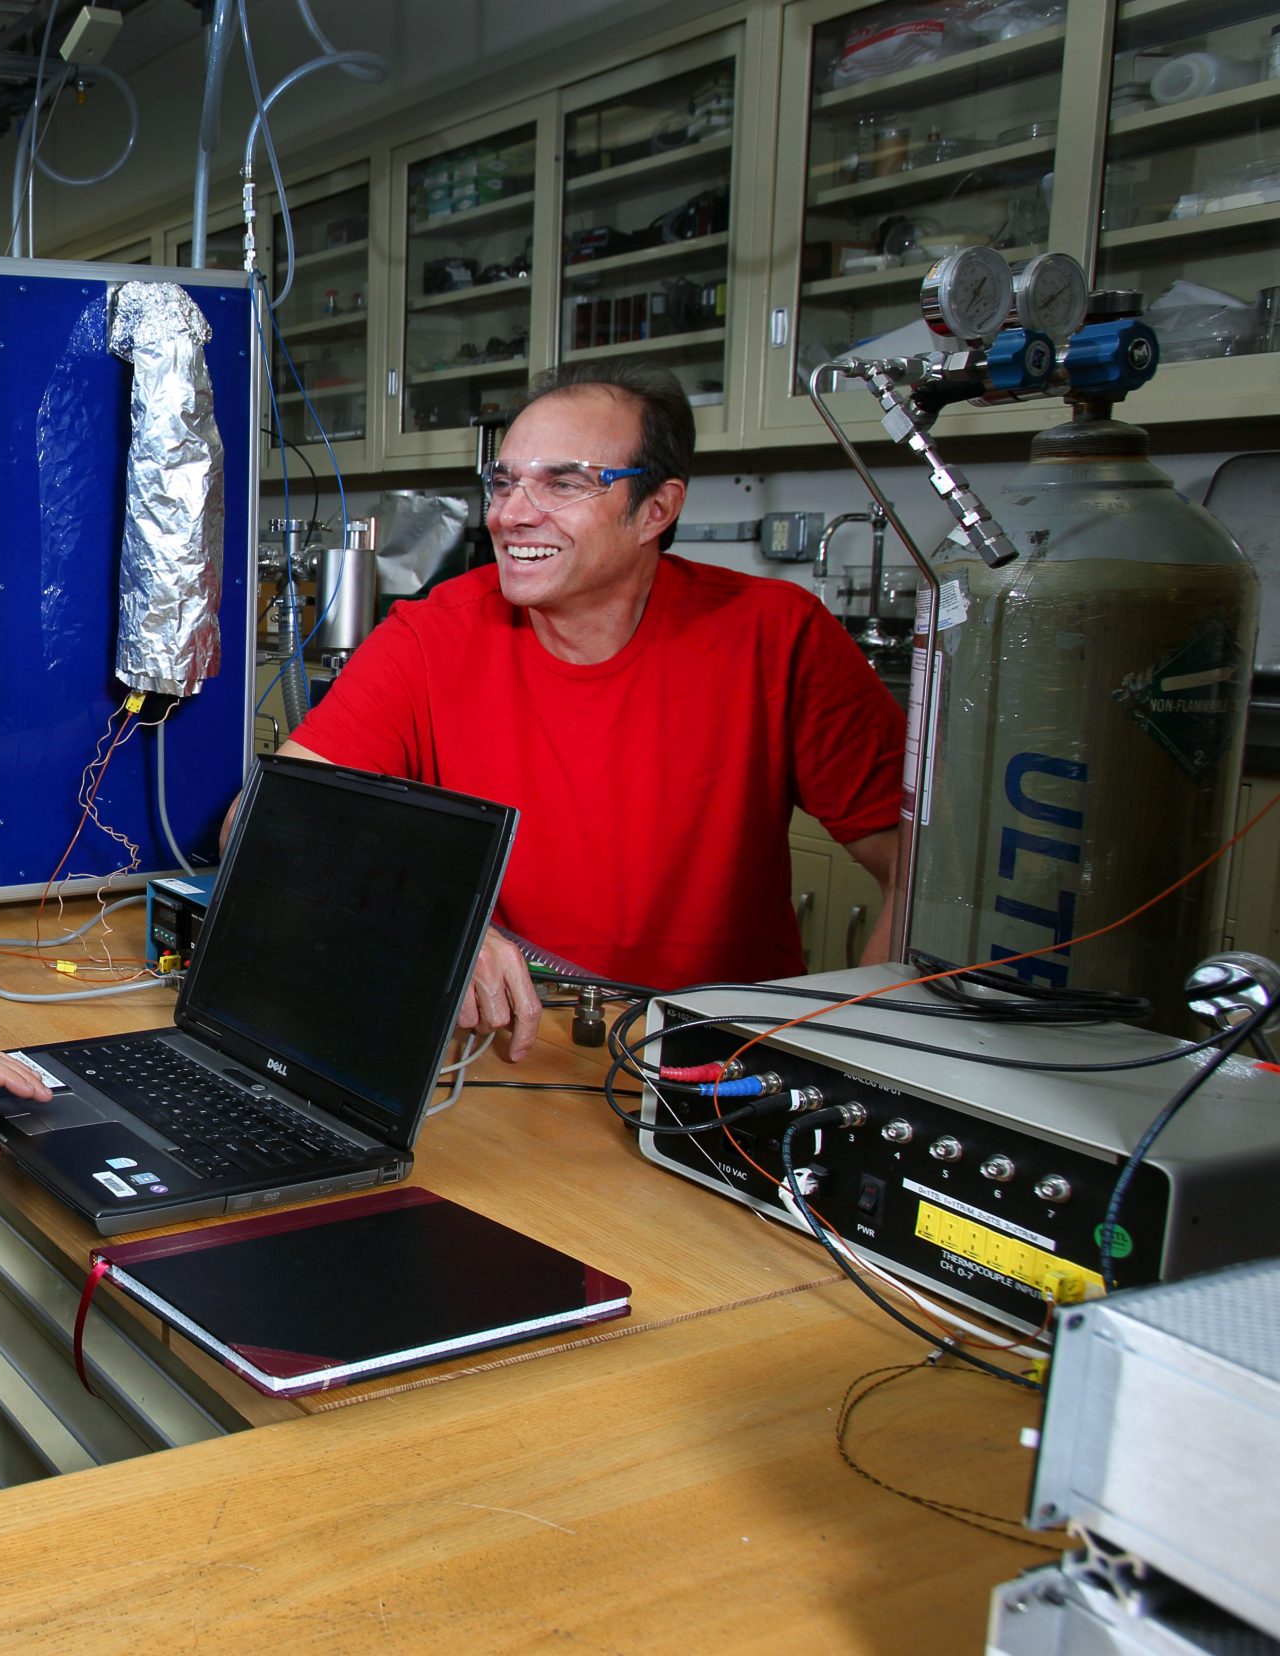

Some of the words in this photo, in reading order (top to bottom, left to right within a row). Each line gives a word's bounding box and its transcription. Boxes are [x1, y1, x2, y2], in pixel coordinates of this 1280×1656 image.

[266, 1057, 287, 1077] DELL
[848, 1134, 855, 1143] 3
[894, 1151, 901, 1160] 4
[718, 1161, 731, 1173] 110
[732, 1168, 748, 1181] VAC
[942, 1169, 949, 1179] 5
[994, 1189, 1001, 1199] 6
[1047, 1209, 1056, 1219] 7
[856, 1223, 875, 1238] PWR
[941, 1249, 1013, 1288] THERMOCOUPLE
[957, 1267, 975, 1280] 0-7
